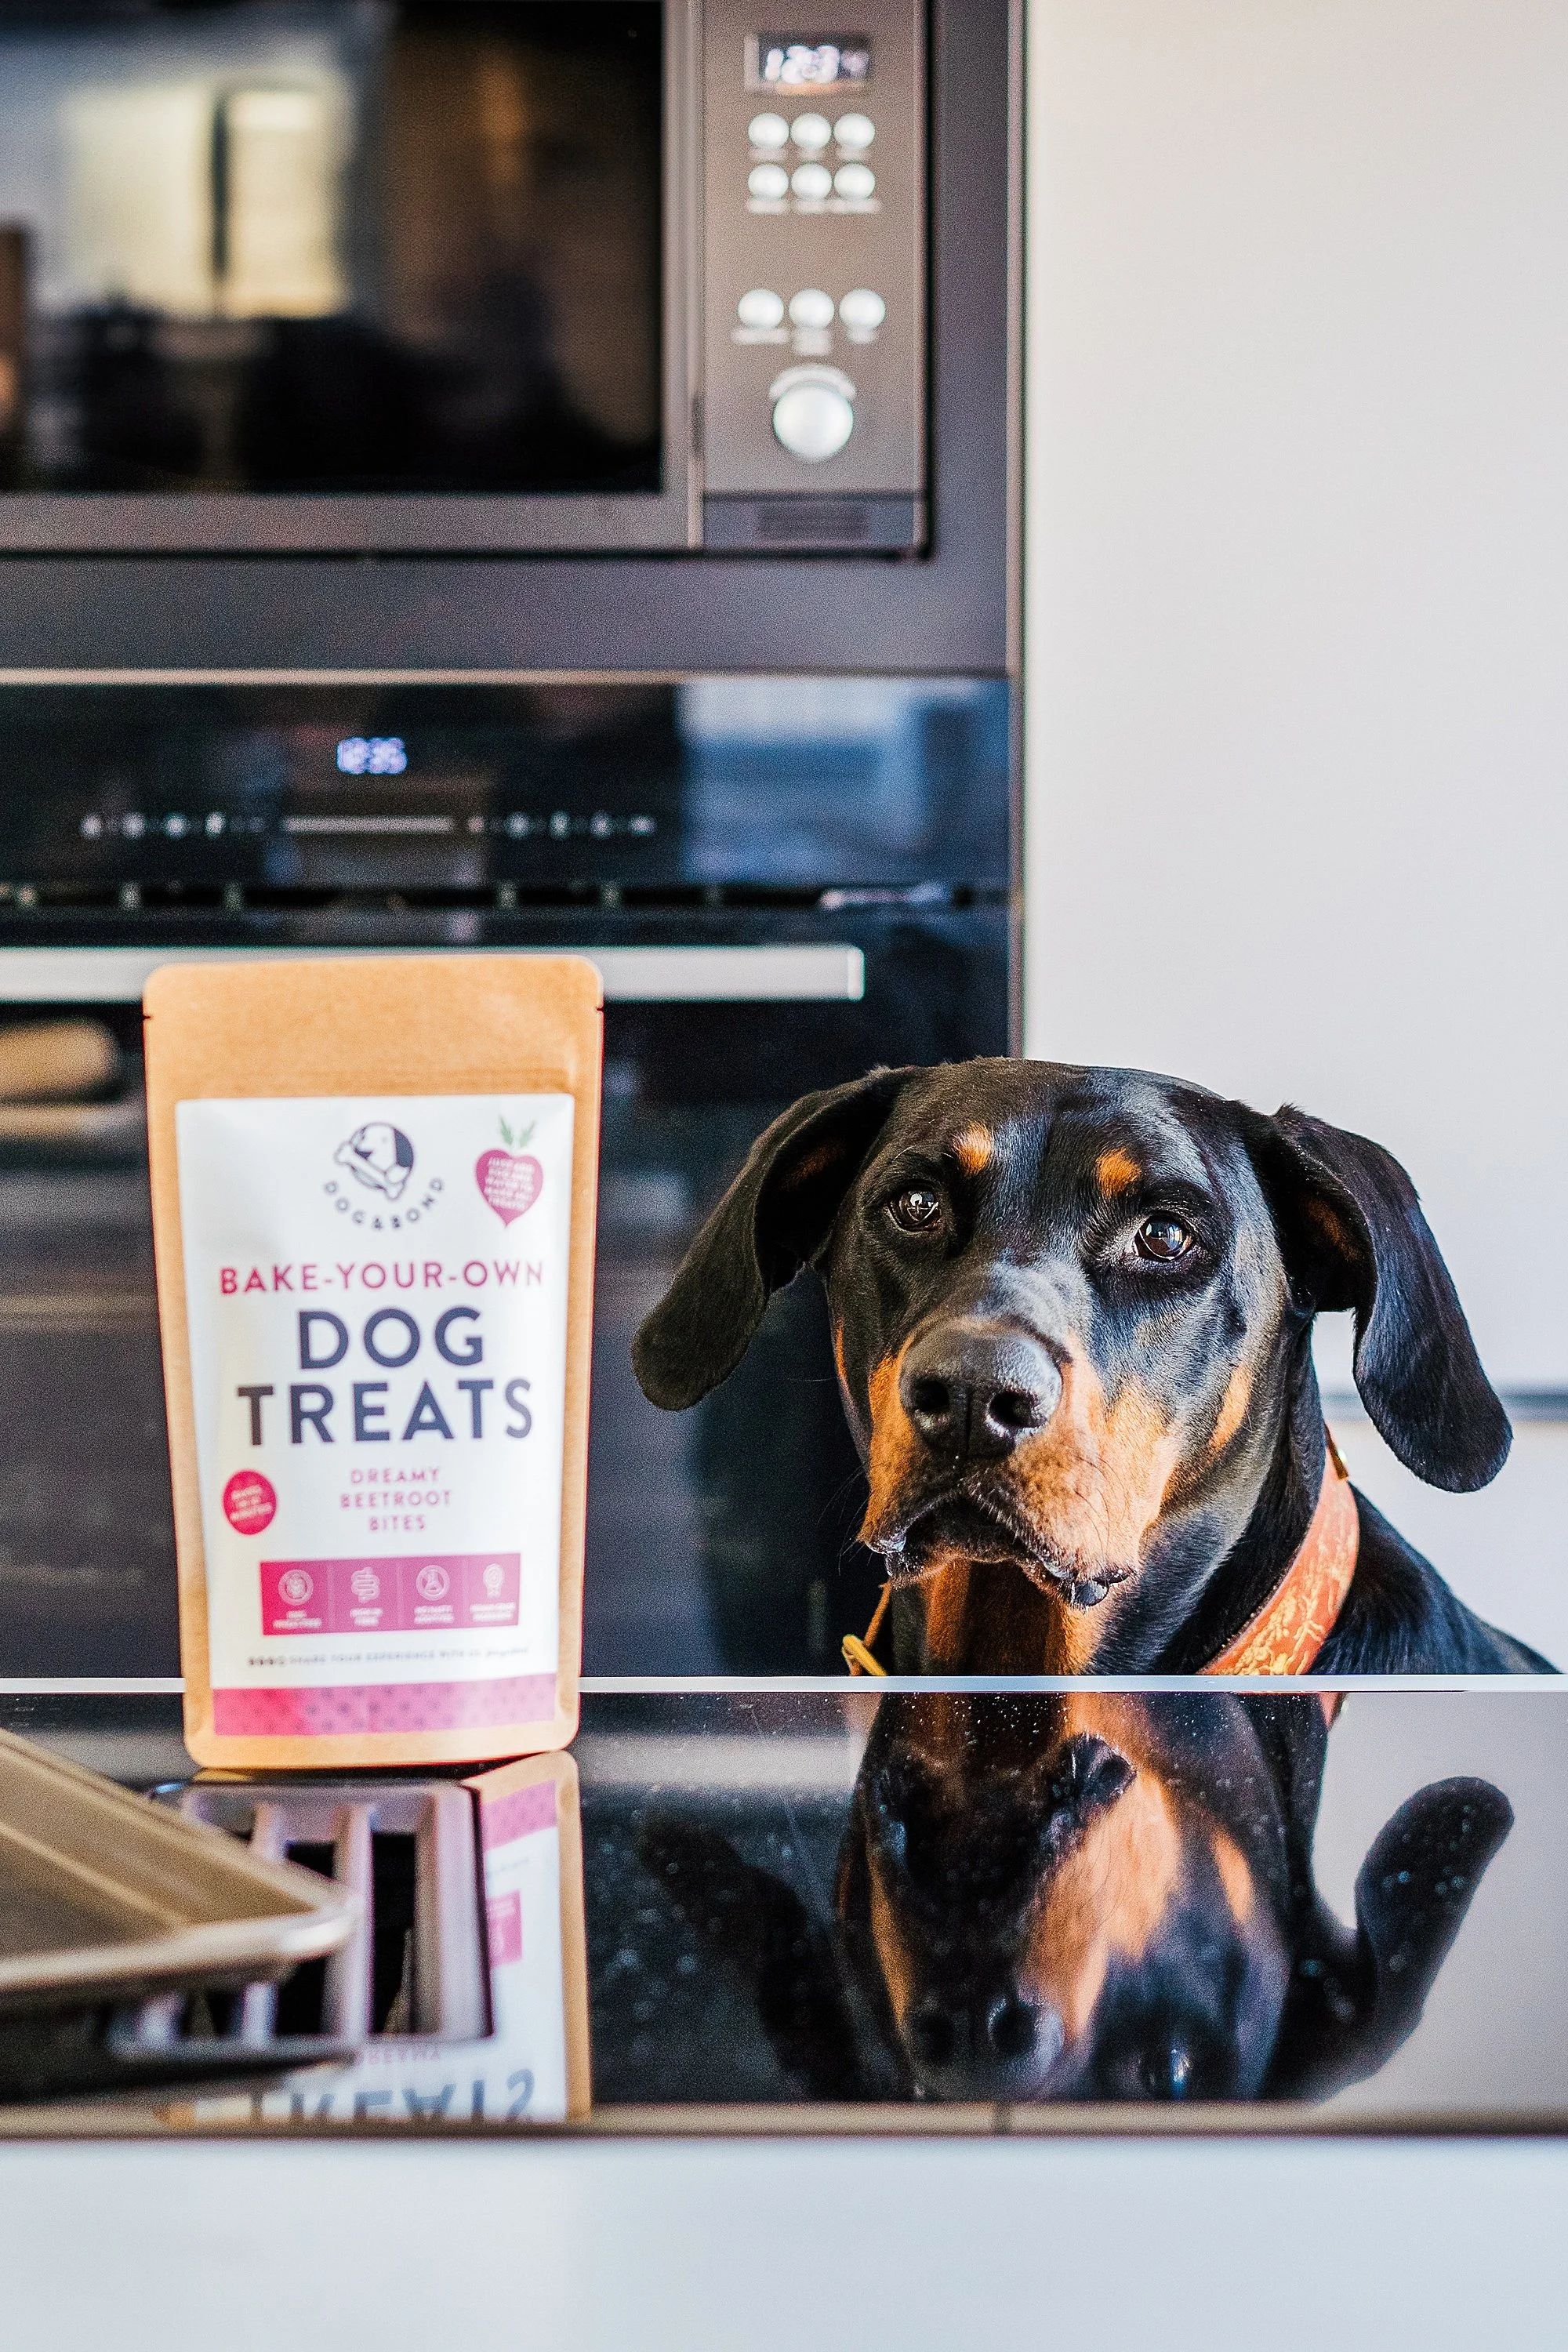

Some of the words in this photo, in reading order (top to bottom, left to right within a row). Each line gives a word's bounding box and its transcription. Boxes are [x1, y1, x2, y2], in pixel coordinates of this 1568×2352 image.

[220, 1258, 543, 1295] BAKE-YOUR-OWN
[299, 1305, 484, 1370] DOG
[238, 1377, 532, 1446] TREATS
[350, 1467, 439, 1483] DREAMY
[340, 1490, 450, 1508] BEETROOT
[369, 1515, 425, 1531] BITES
